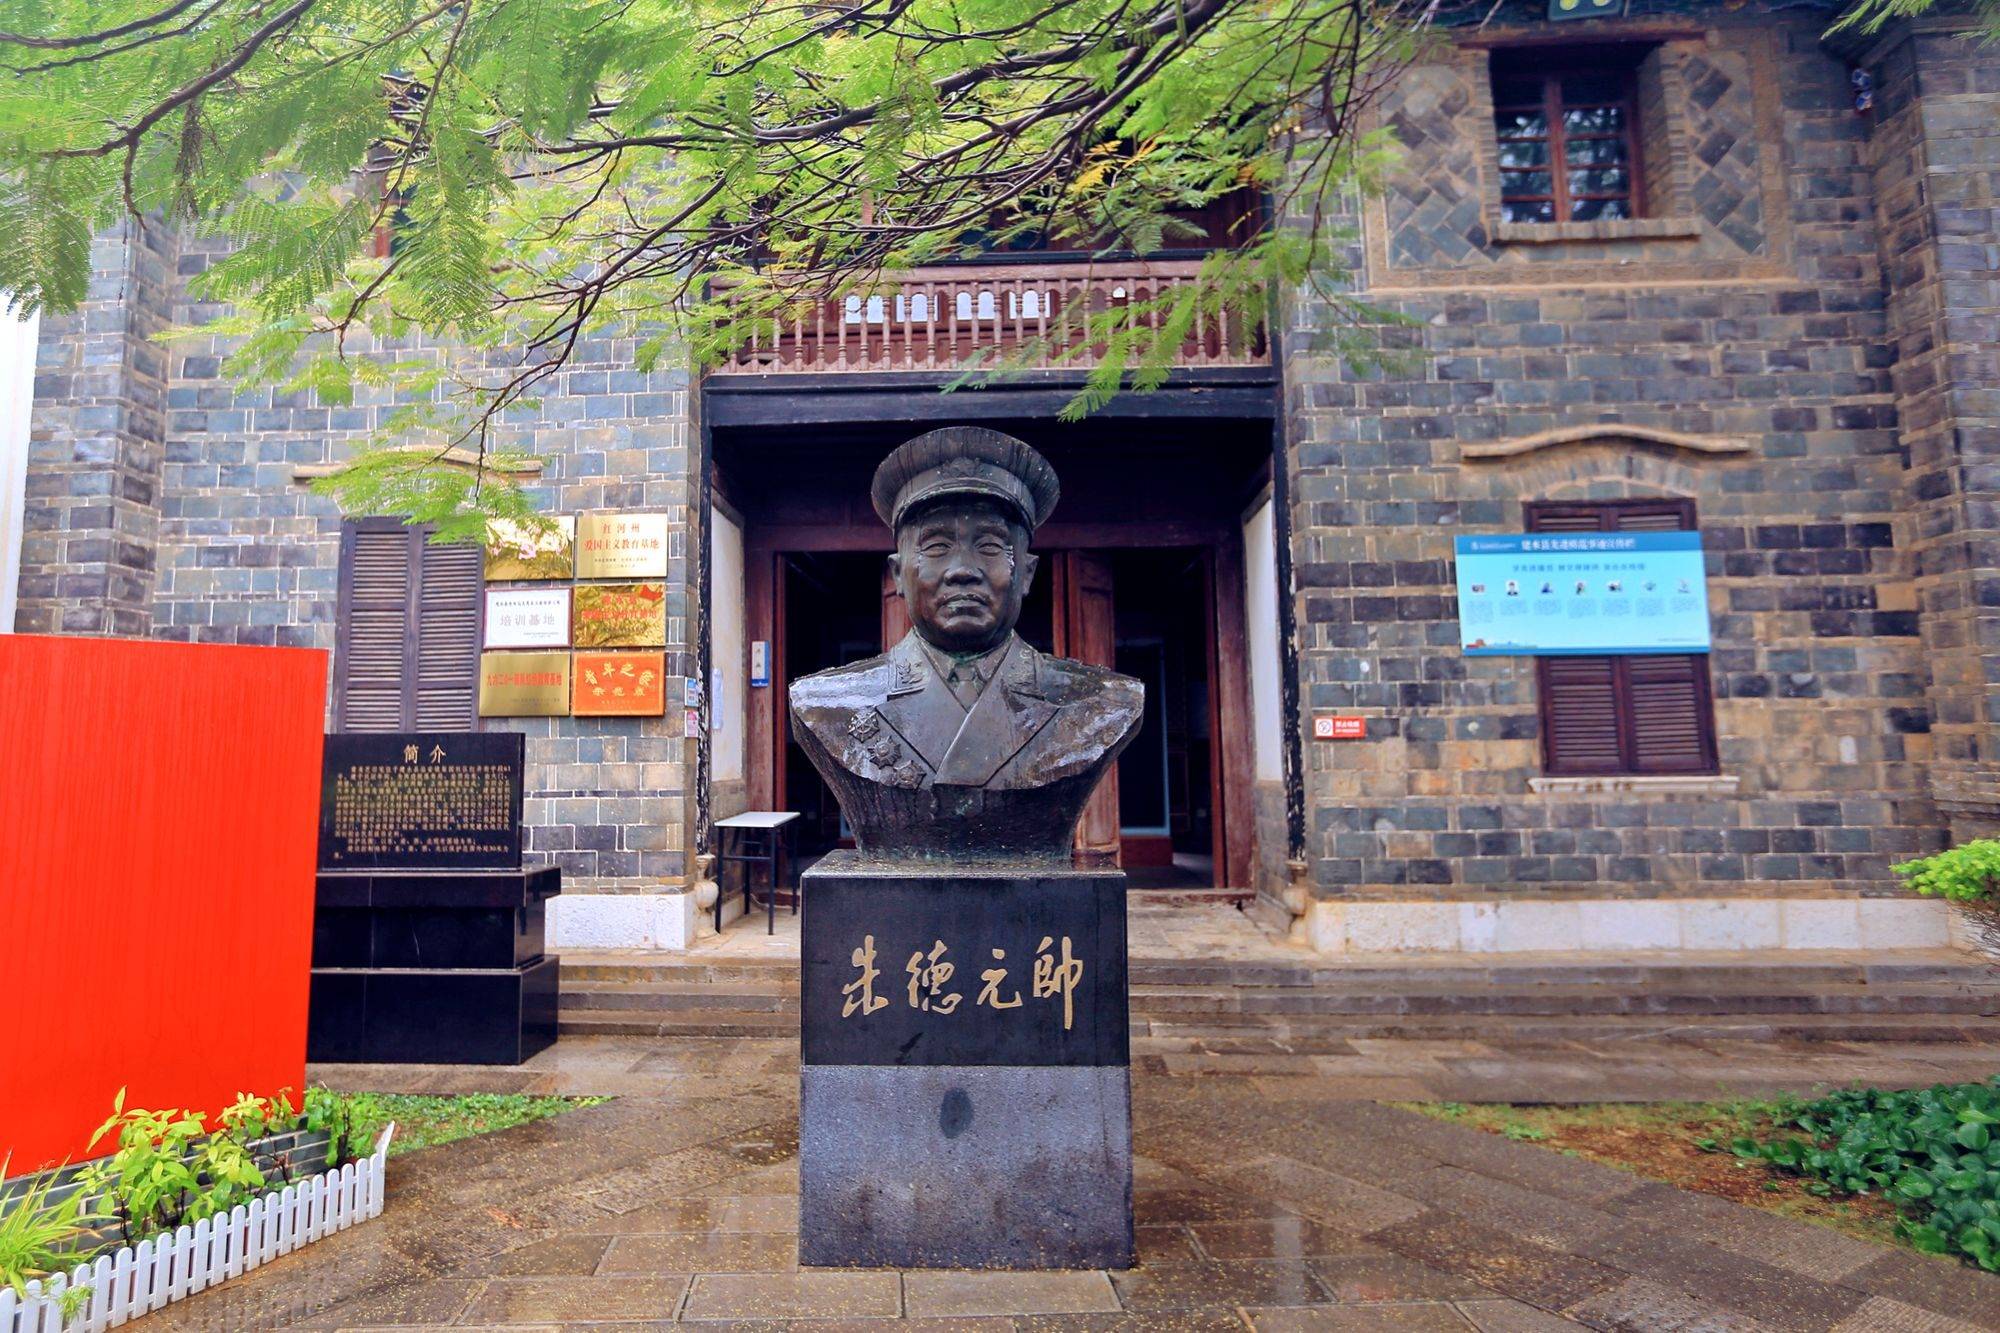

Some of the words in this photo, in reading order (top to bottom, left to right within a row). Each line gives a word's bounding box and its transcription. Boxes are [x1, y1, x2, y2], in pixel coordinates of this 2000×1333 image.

[601, 522, 640, 534] 红河州
[584, 538, 660, 552] 爱国主义教育基地
[500, 613, 555, 627] 培训基地
[403, 743, 446, 764] 简介
